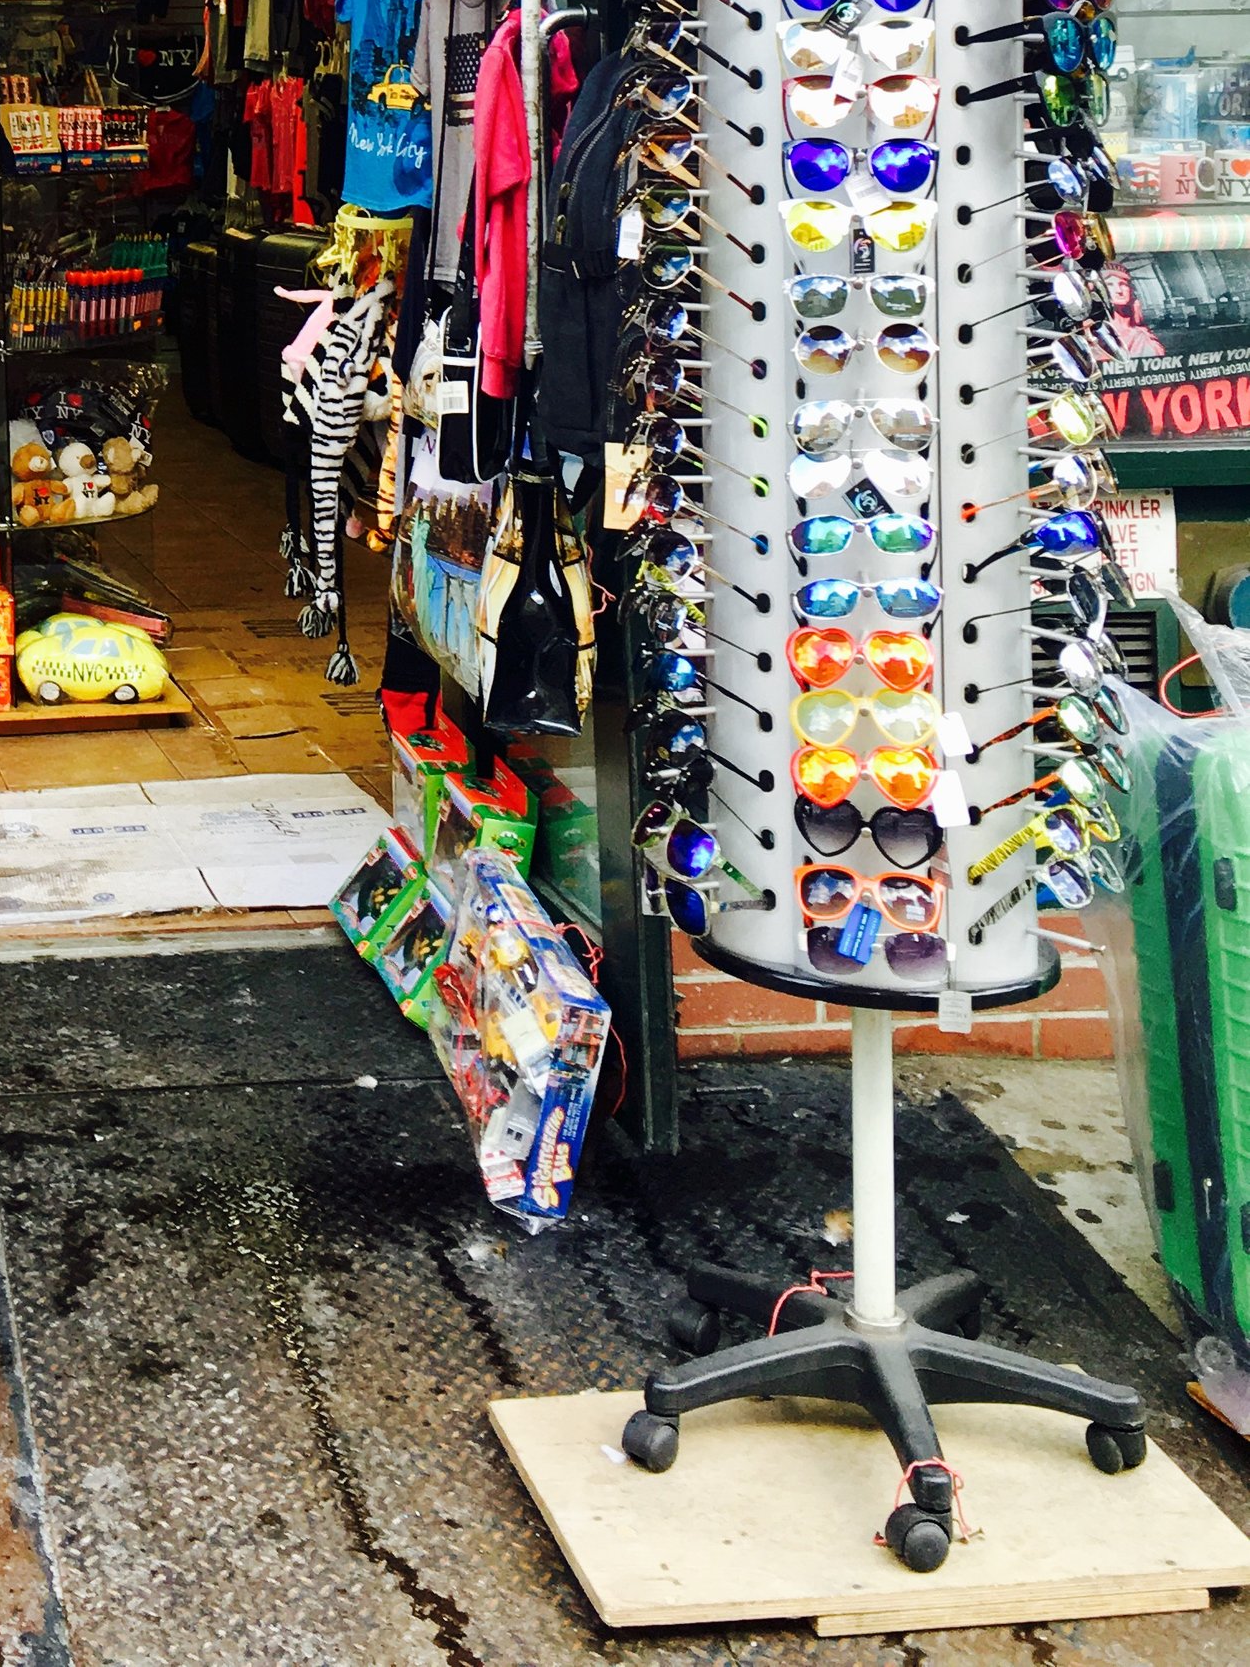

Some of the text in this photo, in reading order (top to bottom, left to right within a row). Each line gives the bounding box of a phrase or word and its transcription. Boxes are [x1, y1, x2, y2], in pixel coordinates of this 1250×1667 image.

[126, 47, 195, 66] I NY
[349, 122, 375, 152] New
[396, 133, 428, 169] City
[1179, 162, 1188, 177] I
[1220, 158, 1229, 176] I
[1103, 347, 1250, 375] NEW YORK NEW YO
[59, 391, 67, 404] I
[55, 405, 84, 420] NY
[82, 491, 95, 499] NY
[83, 482, 88, 491] I
[1089, 500, 1161, 519] RINKLER
[1109, 524, 1138, 543] LVE
[1130, 572, 1157, 592] IGN
[73, 662, 103, 682] NYC
[552, 1142, 574, 1184] BUS
